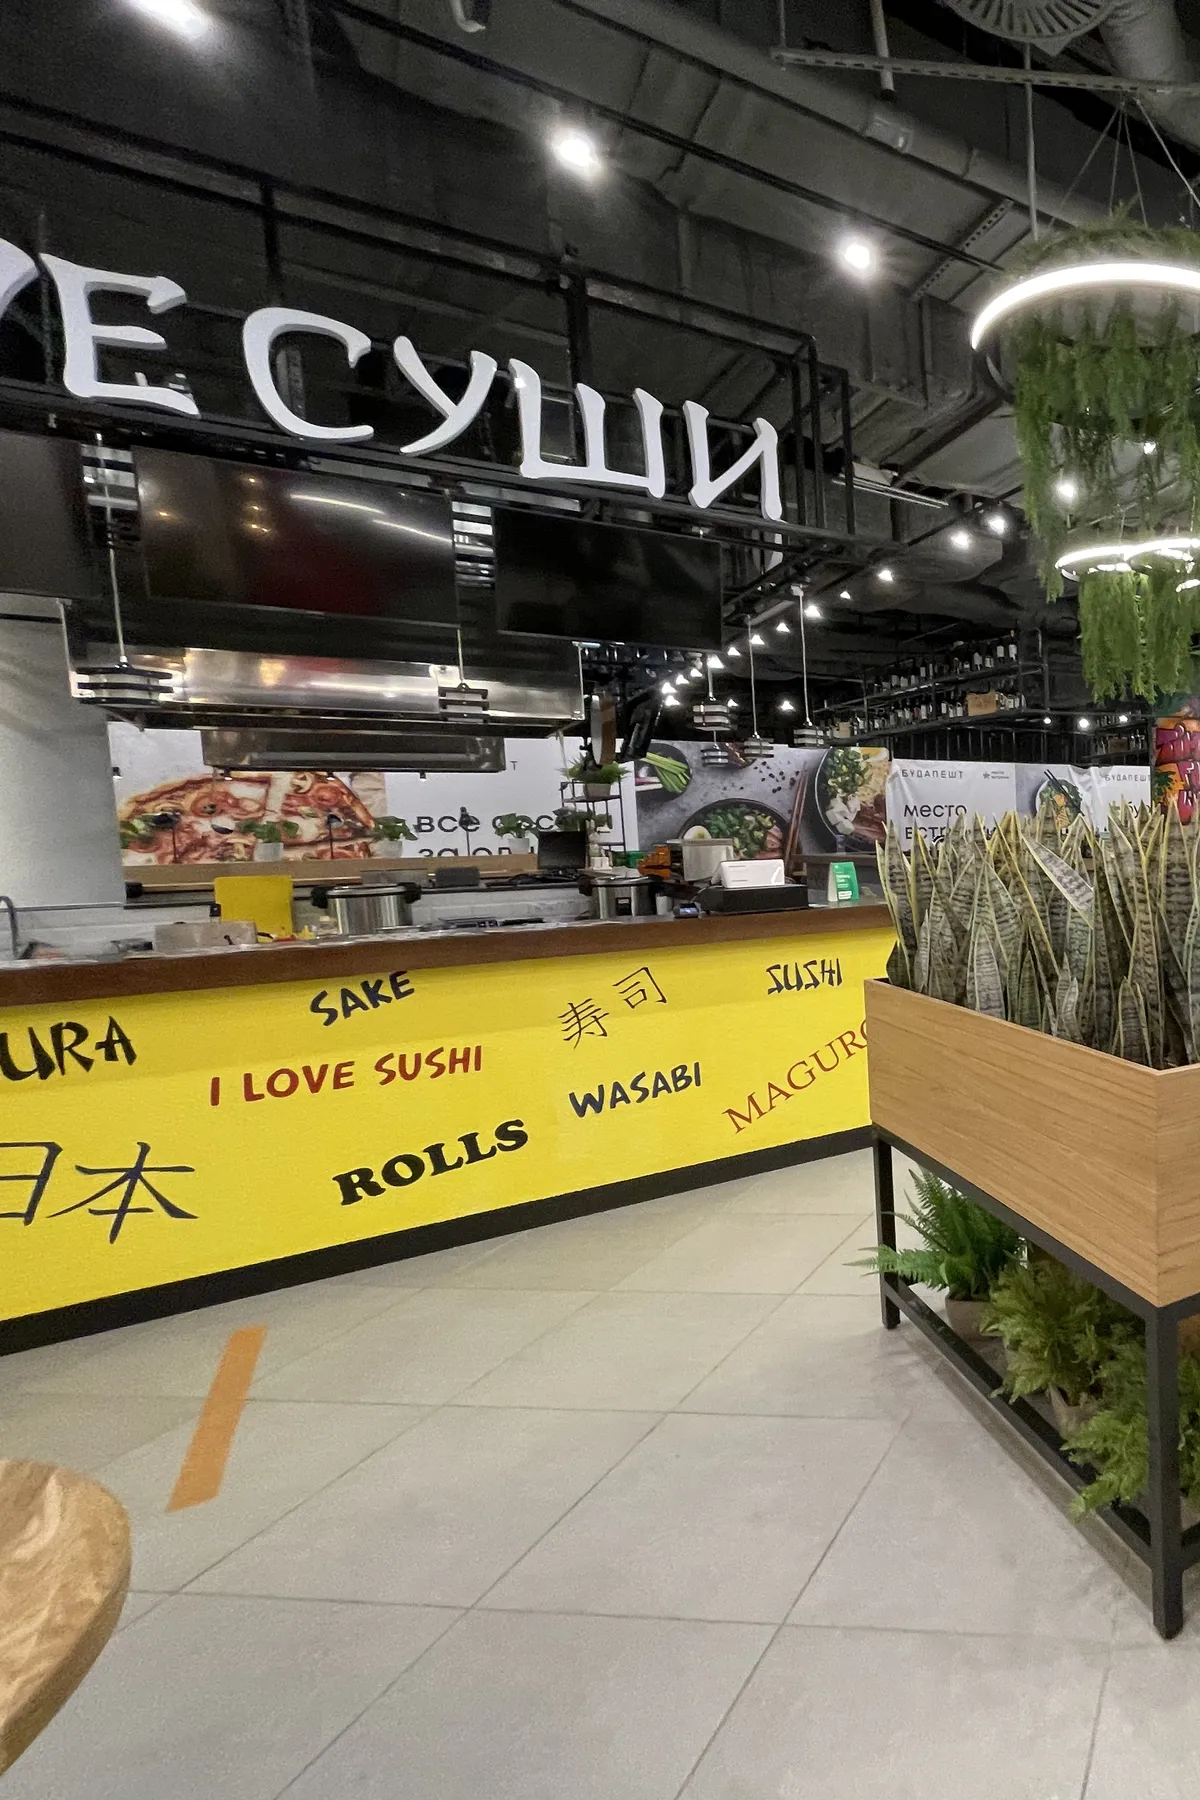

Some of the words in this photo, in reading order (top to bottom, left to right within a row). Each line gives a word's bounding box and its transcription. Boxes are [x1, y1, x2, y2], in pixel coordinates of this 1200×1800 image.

[243, 307, 783, 521] СУШИ
[901, 769, 963, 779] БУДАПЕШТ
[309, 970, 416, 1027] SAKE
[765, 958, 843, 995] SUSHI
[557, 966, 668, 1050] 寿司
[0, 1015, 137, 1081] URA
[209, 1076, 221, 1107] I
[243, 1060, 356, 1102] LOVE
[374, 1045, 483, 1086] SUSHI
[568, 1061, 702, 1119] WASABI
[332, 1118, 530, 1207] ROLLS
